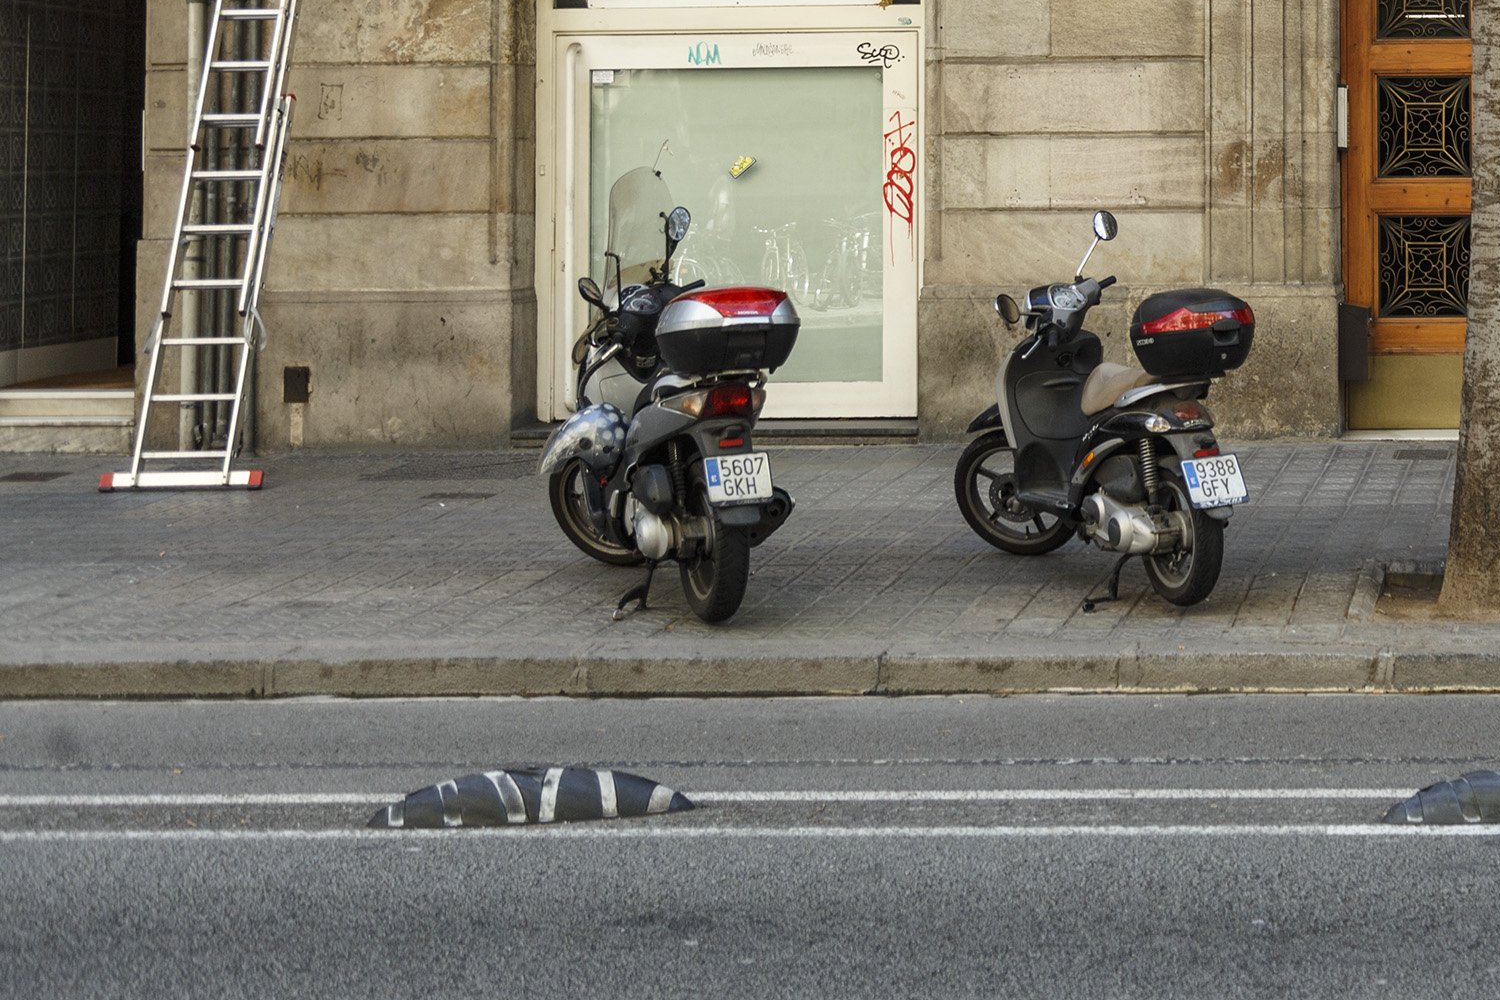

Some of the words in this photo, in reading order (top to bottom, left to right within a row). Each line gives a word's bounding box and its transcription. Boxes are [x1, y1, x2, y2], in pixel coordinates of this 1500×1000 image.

[720, 456, 764, 477] 5607
[1195, 459, 1237, 479] 9388
[723, 476, 758, 497] GKH
[1201, 477, 1231, 498] GFY
